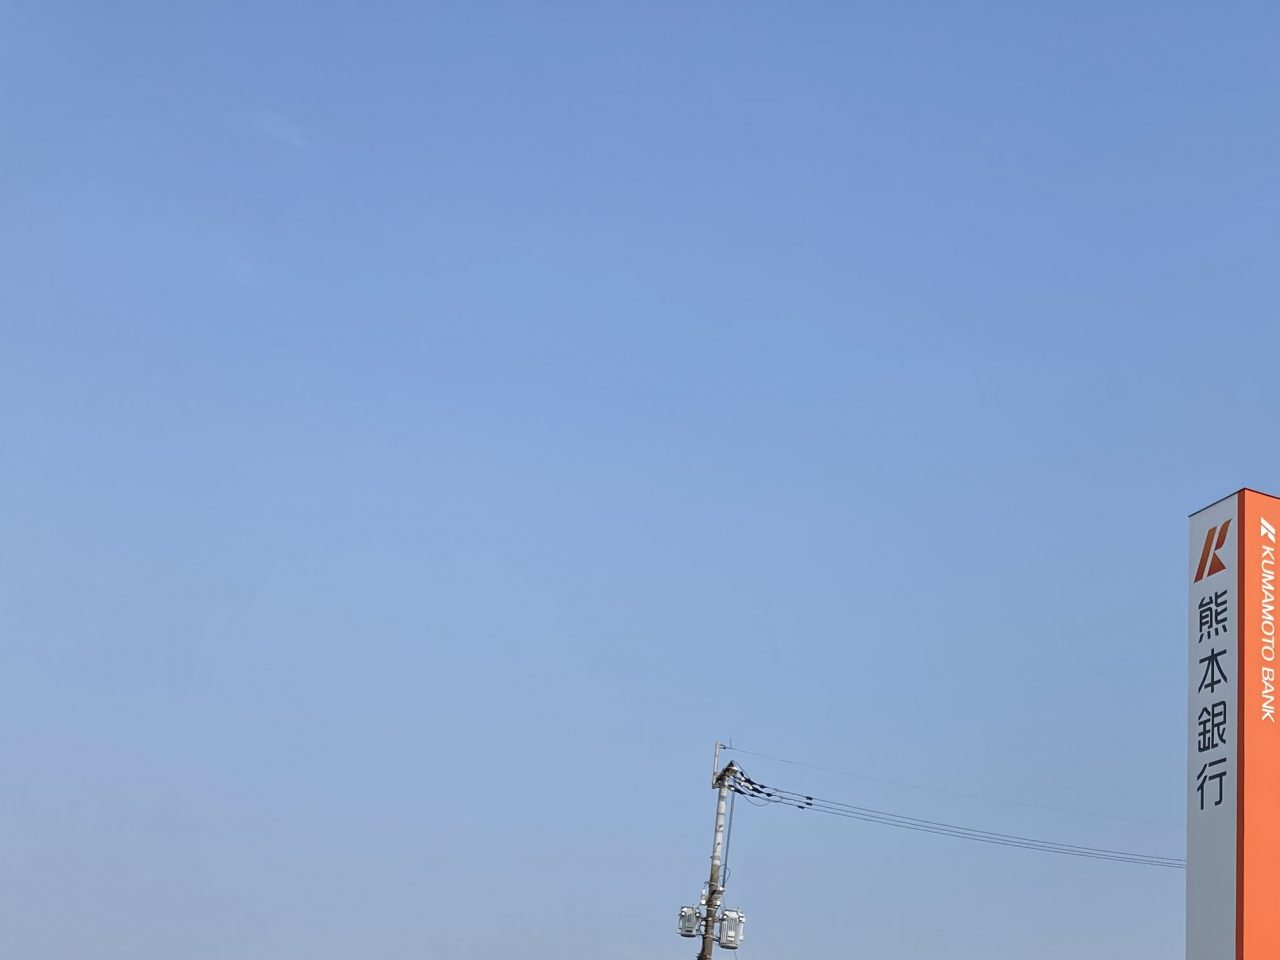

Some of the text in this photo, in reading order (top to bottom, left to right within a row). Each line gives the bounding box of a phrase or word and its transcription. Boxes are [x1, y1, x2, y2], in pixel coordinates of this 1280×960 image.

[1196, 589, 1228, 811] 熊本銀行
[1260, 545, 1276, 723] KUMAMOTO BANK
